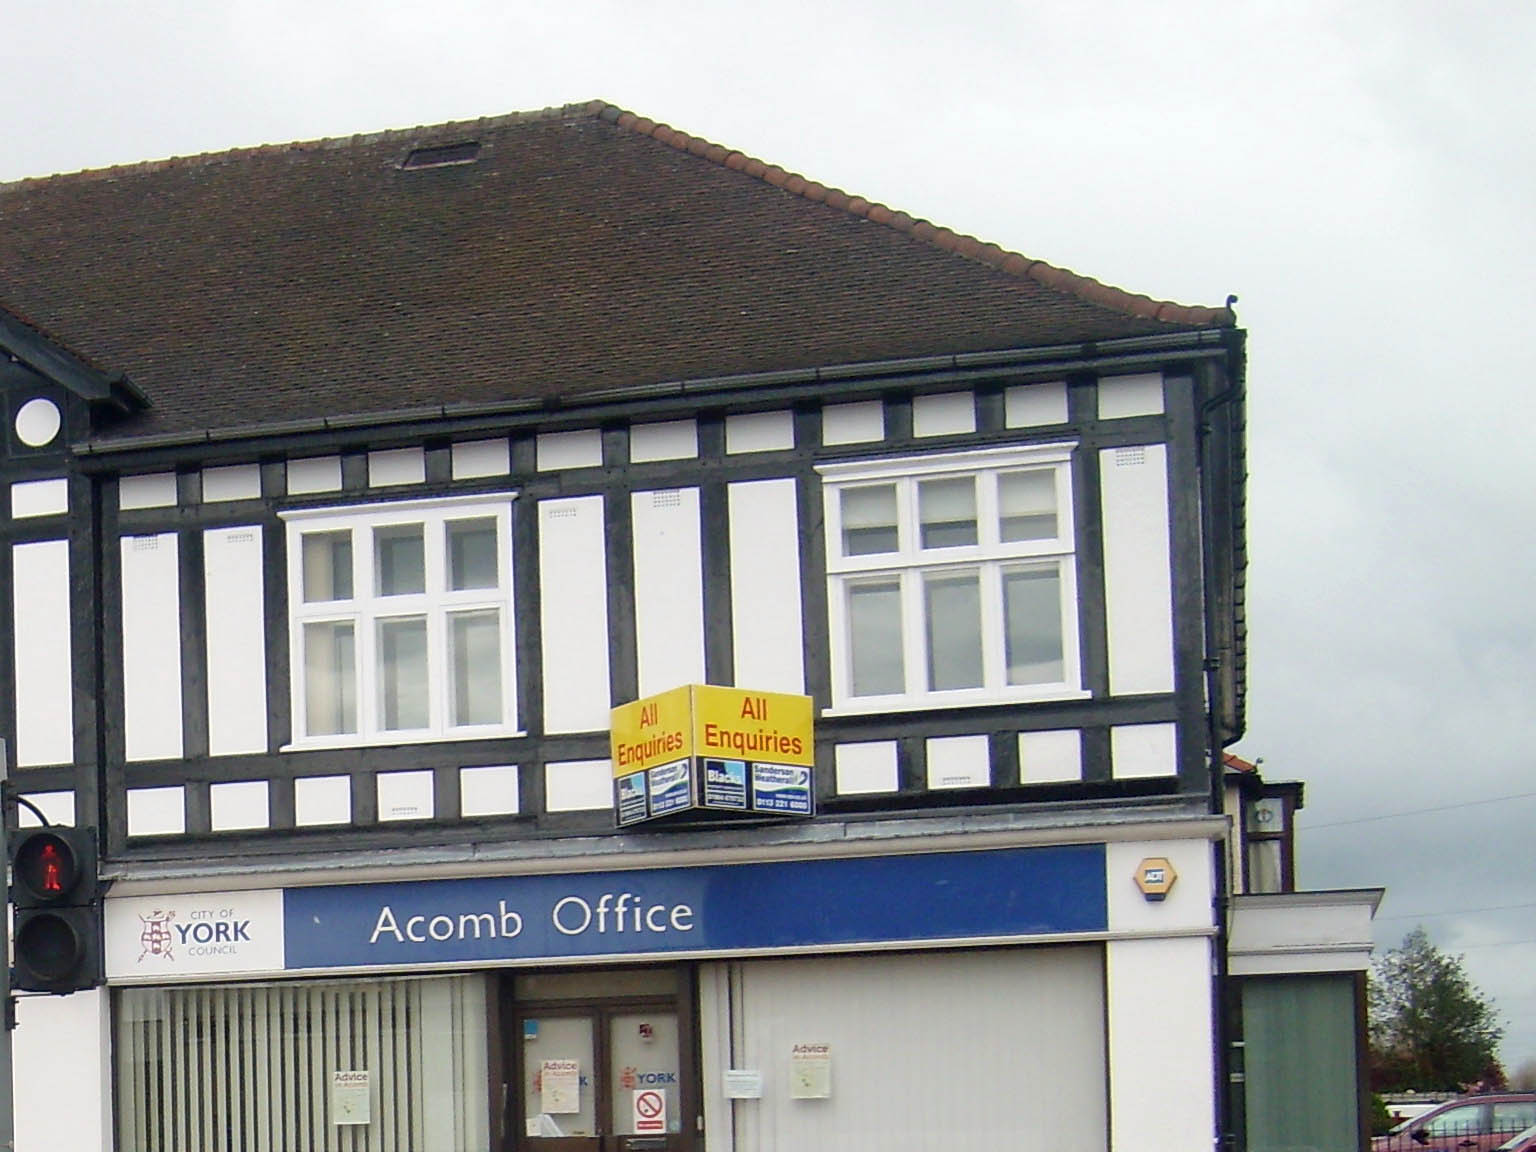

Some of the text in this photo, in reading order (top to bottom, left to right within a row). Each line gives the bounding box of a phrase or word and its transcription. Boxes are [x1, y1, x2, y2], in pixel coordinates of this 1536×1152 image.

[640, 702, 658, 730] All
[741, 696, 767, 721] All
[705, 723, 802, 756] Enquiries
[618, 731, 683, 767] Enquiries
[190, 908, 234, 920] CITY OF
[369, 893, 695, 943] Acomb Office
[175, 920, 251, 945] YORK
[188, 945, 238, 957] COUNCIL
[792, 1044, 829, 1054] Advice
[543, 1062, 577, 1071] Advice
[335, 1072, 368, 1081] Advice
[638, 1072, 676, 1084] YORK
